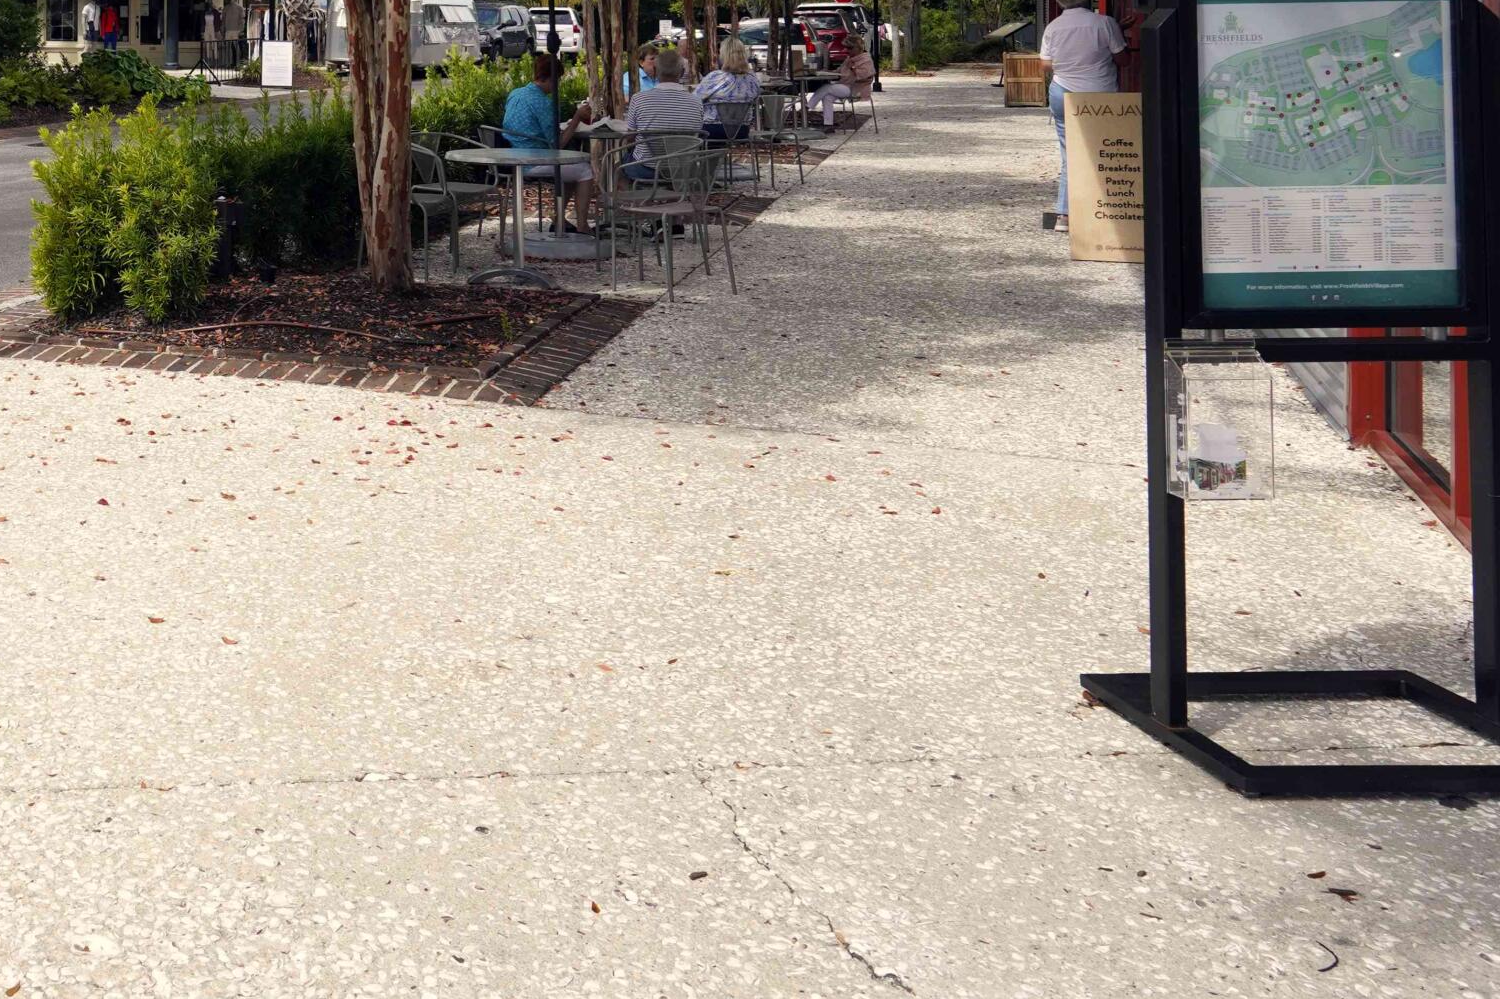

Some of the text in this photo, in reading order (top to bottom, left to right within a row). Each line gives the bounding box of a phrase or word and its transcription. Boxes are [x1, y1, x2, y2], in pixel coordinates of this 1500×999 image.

[1200, 34, 1264, 42] FRESHFIELDS
[1072, 104, 1142, 117] JAVA JAV
[1102, 138, 1134, 147] Coffee
[1099, 149, 1139, 160] Espresso
[1098, 163, 1141, 173] Breakfast
[1105, 176, 1135, 188] Pastry
[1106, 188, 1135, 197] Lunch
